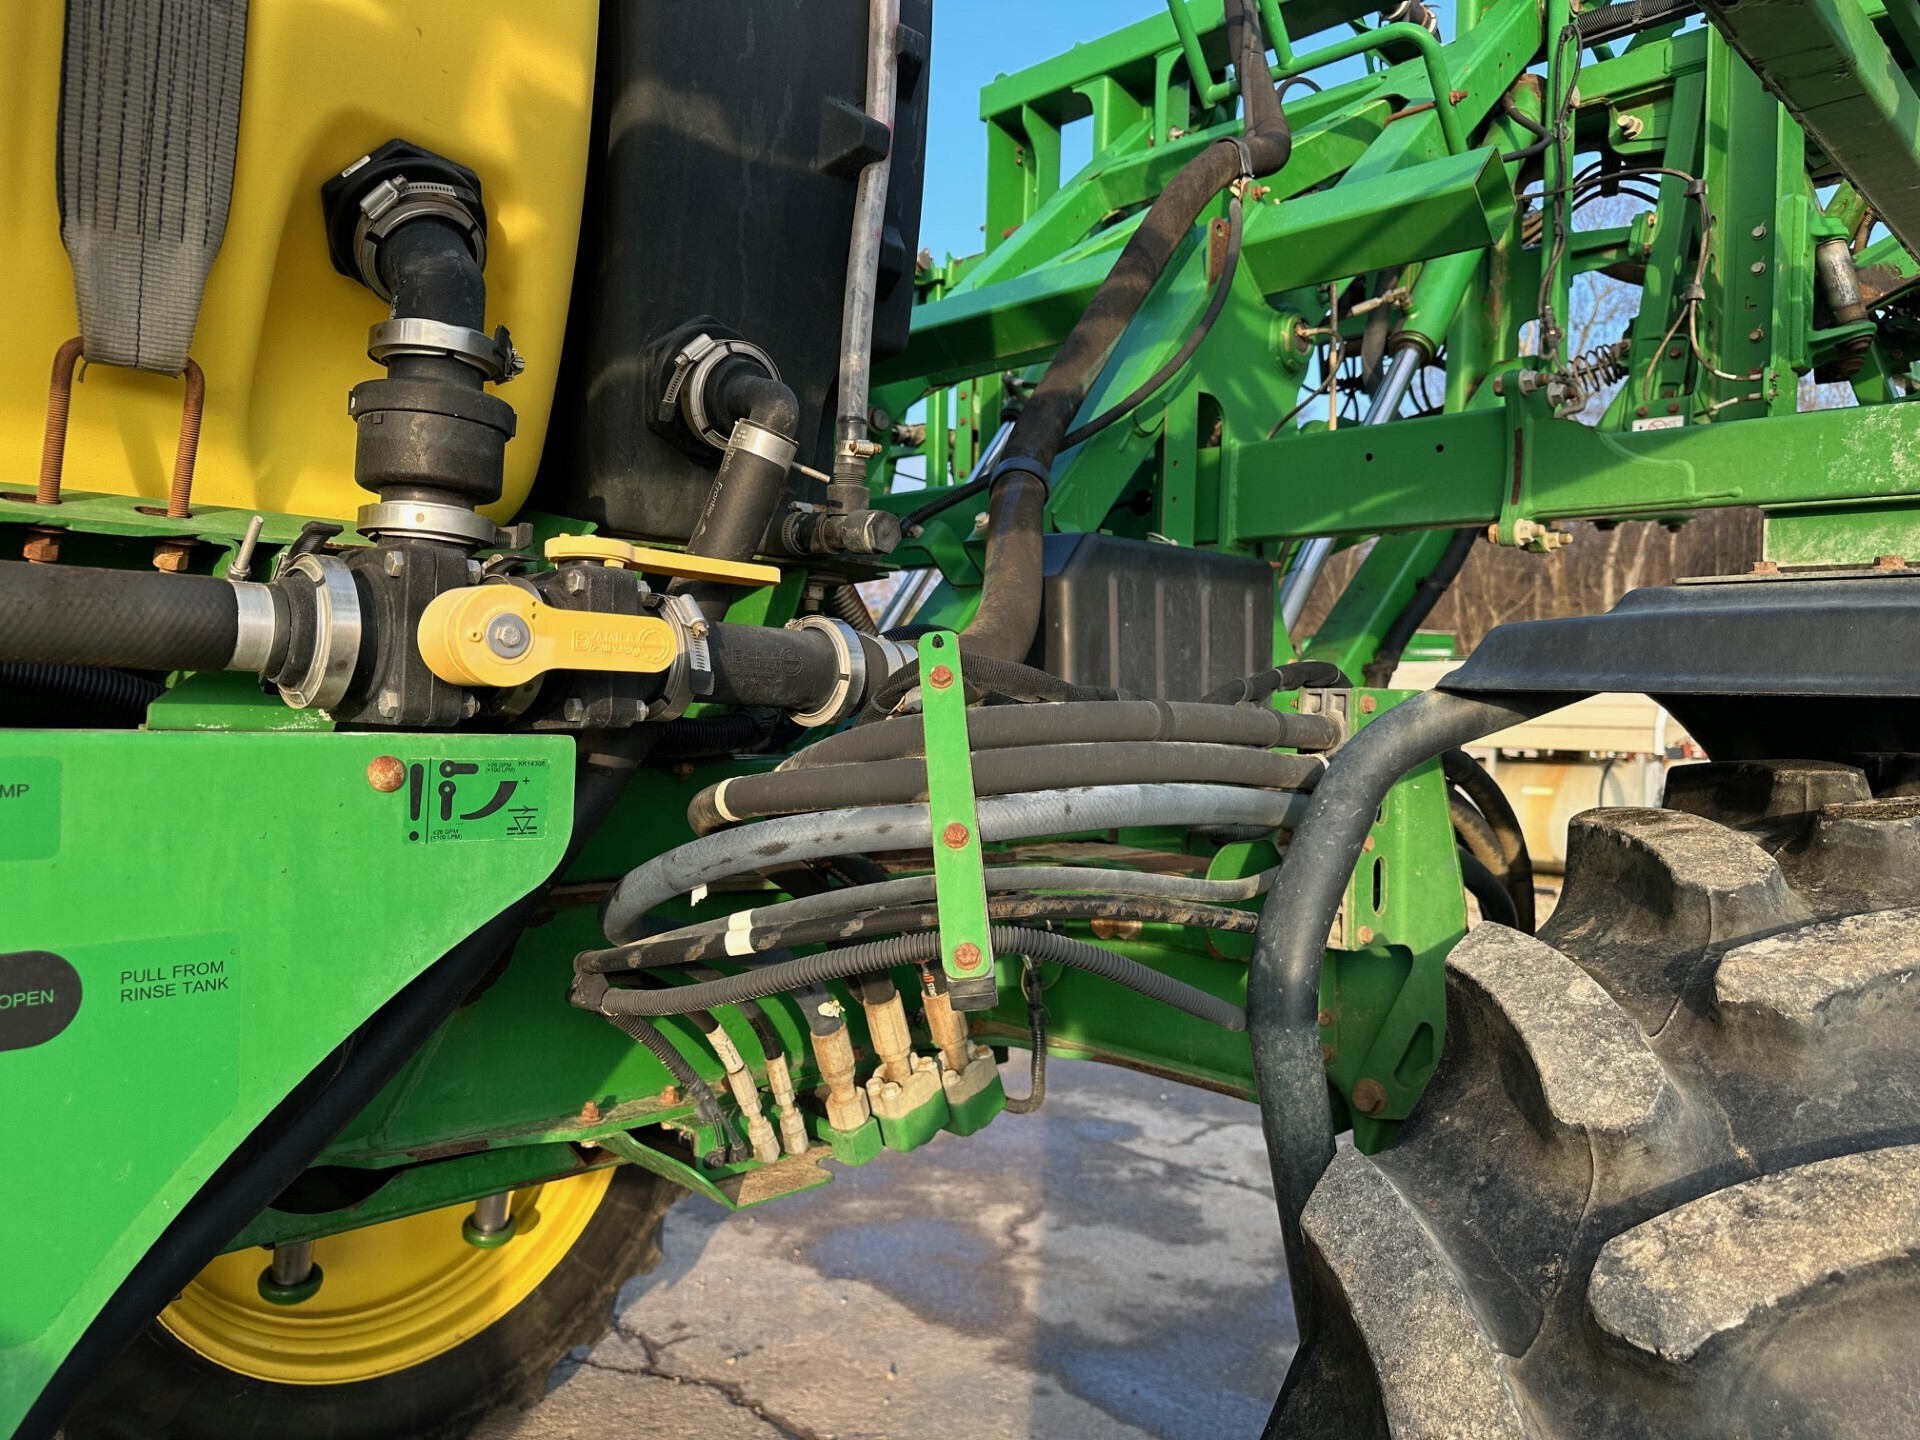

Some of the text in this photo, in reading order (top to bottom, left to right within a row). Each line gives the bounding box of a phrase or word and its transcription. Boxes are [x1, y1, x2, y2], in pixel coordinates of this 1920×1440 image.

[706, 481, 723, 518] Frontier
[121, 960, 224, 984] PULL FROM
[0, 989, 54, 1009] OPEN
[120, 976, 229, 1003] RINSE TANK
